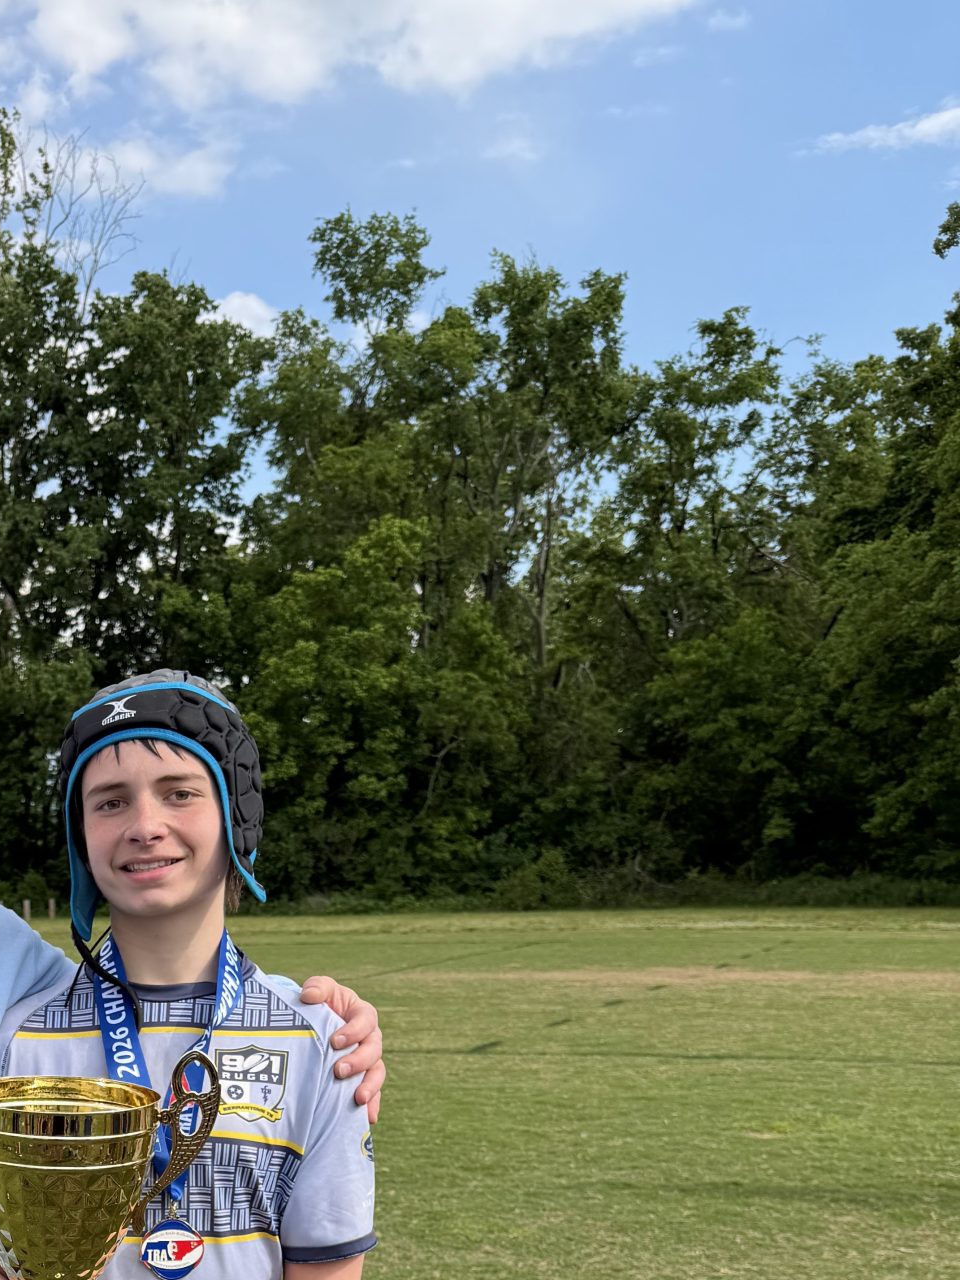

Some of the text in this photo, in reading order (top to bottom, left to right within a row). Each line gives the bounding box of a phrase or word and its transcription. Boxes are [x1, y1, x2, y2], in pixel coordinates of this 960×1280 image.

[101, 713, 135, 726] GILBERT
[109, 1026, 140, 1079] 2026
[221, 1071, 279, 1082] RUGBY
[147, 1249, 168, 1262] TRA
